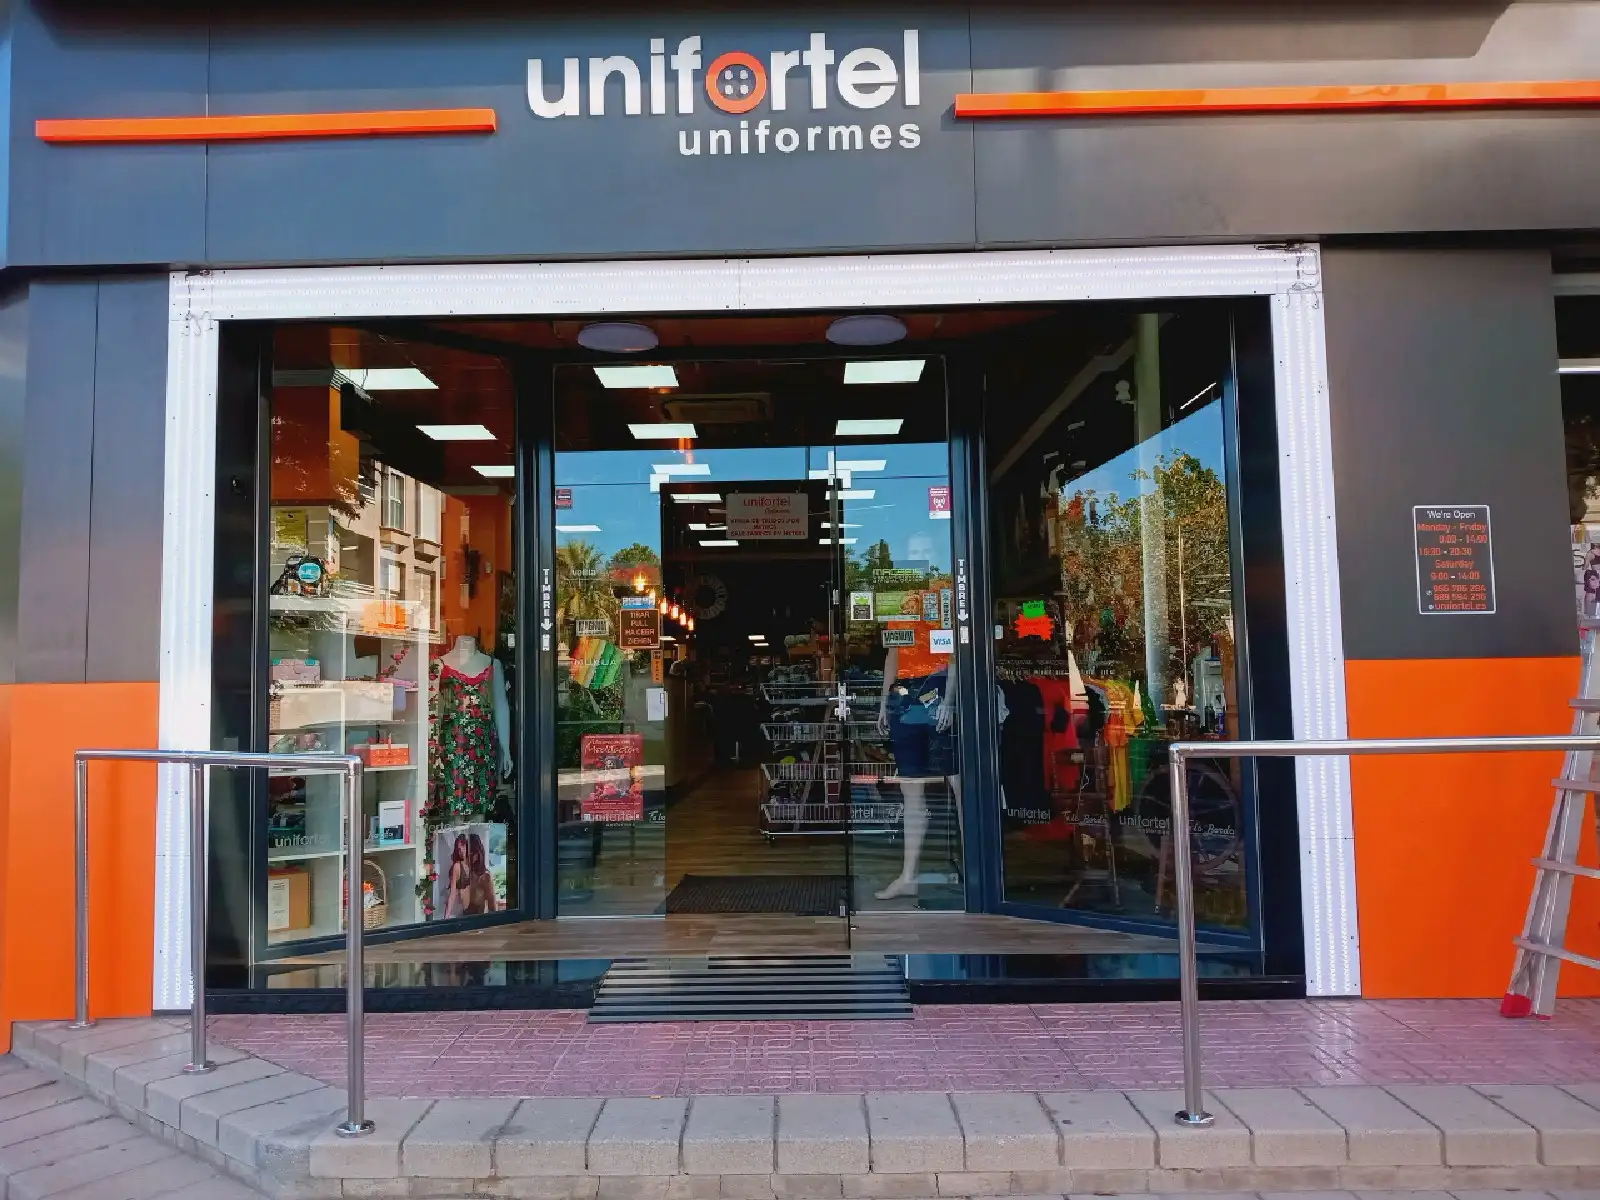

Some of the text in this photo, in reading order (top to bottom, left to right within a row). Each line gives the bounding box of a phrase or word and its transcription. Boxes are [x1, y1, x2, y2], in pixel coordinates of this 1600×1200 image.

[527, 29, 920, 118] unifortel
[679, 120, 921, 156] uniformes
[1427, 510, 1476, 520] We're Open
[1416, 523, 1450, 534] Monday
[1460, 522, 1488, 532] Friday
[1435, 560, 1474, 570] Saturday
[542, 568, 551, 617] TIMBRE
[957, 558, 966, 608] TIMBRE
[1119, 814, 1170, 829] unifortel
